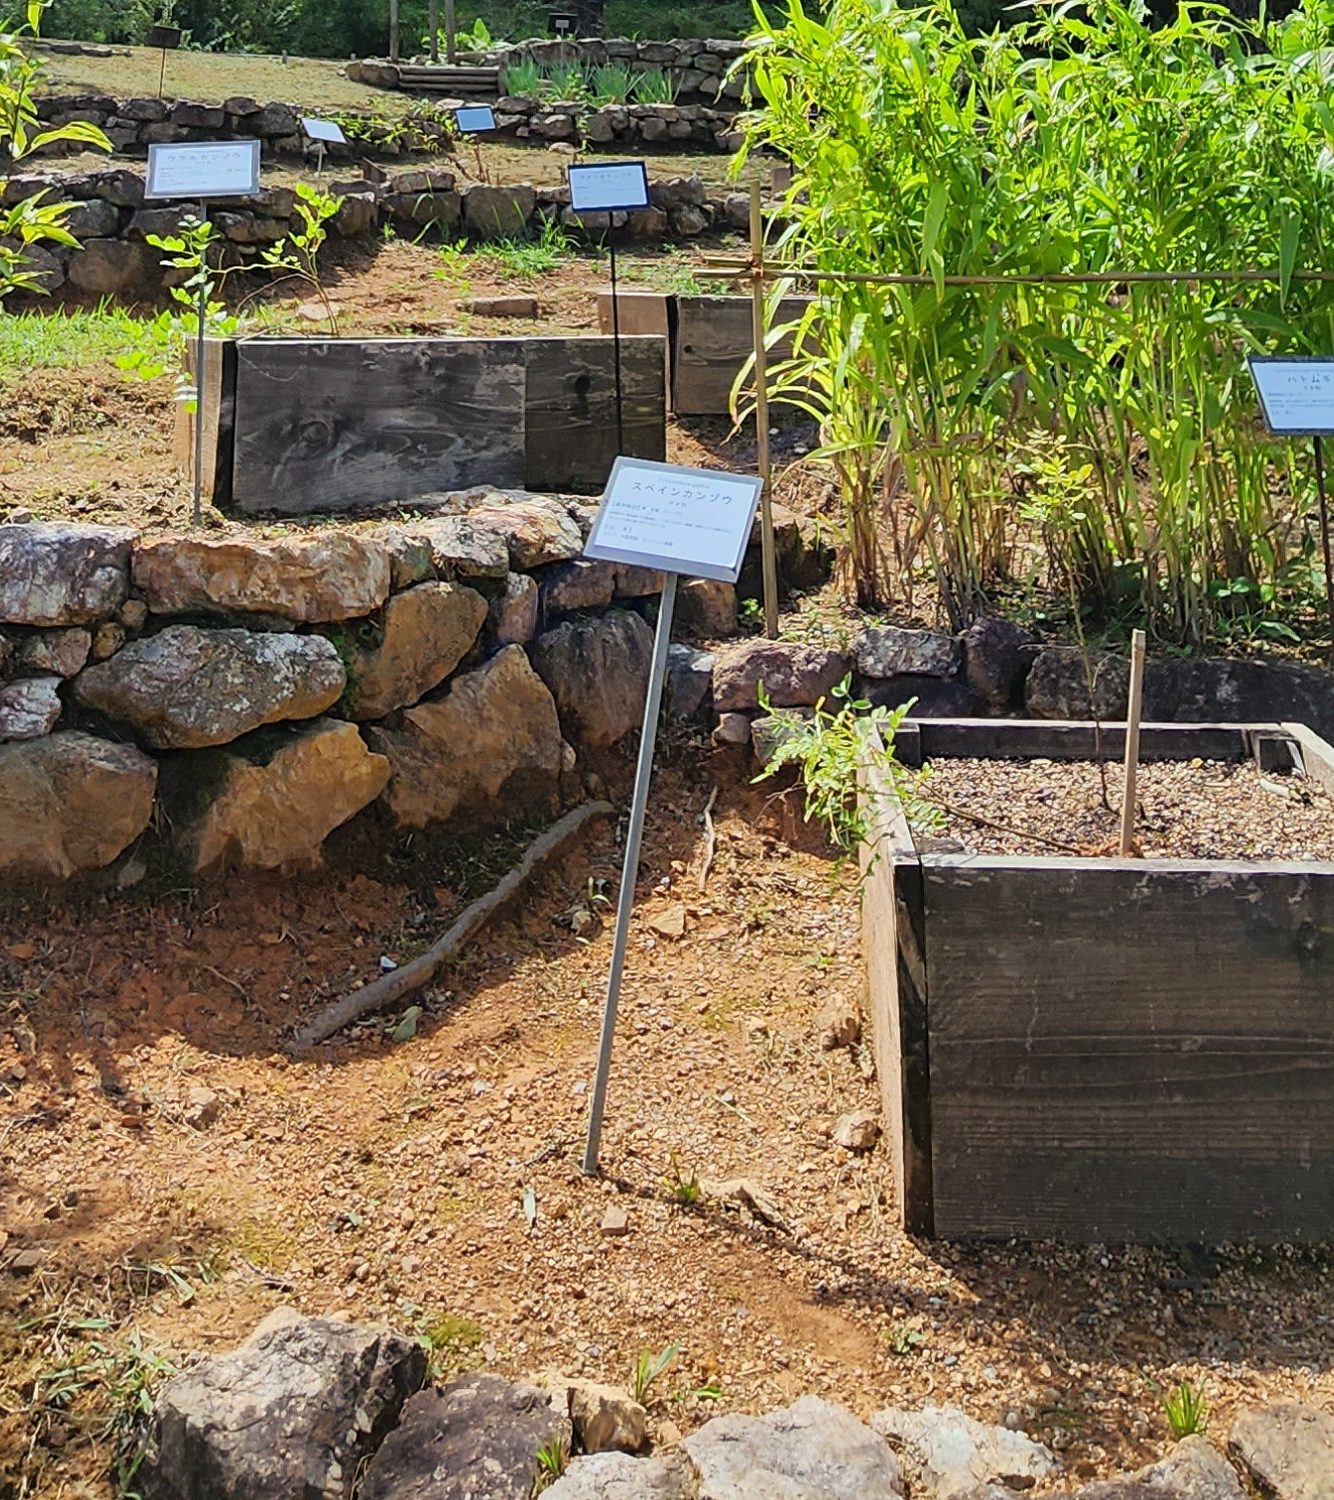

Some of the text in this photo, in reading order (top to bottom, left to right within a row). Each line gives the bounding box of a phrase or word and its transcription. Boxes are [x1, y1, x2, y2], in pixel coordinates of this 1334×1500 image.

[631, 482, 732, 505] スペインカンゾウ
